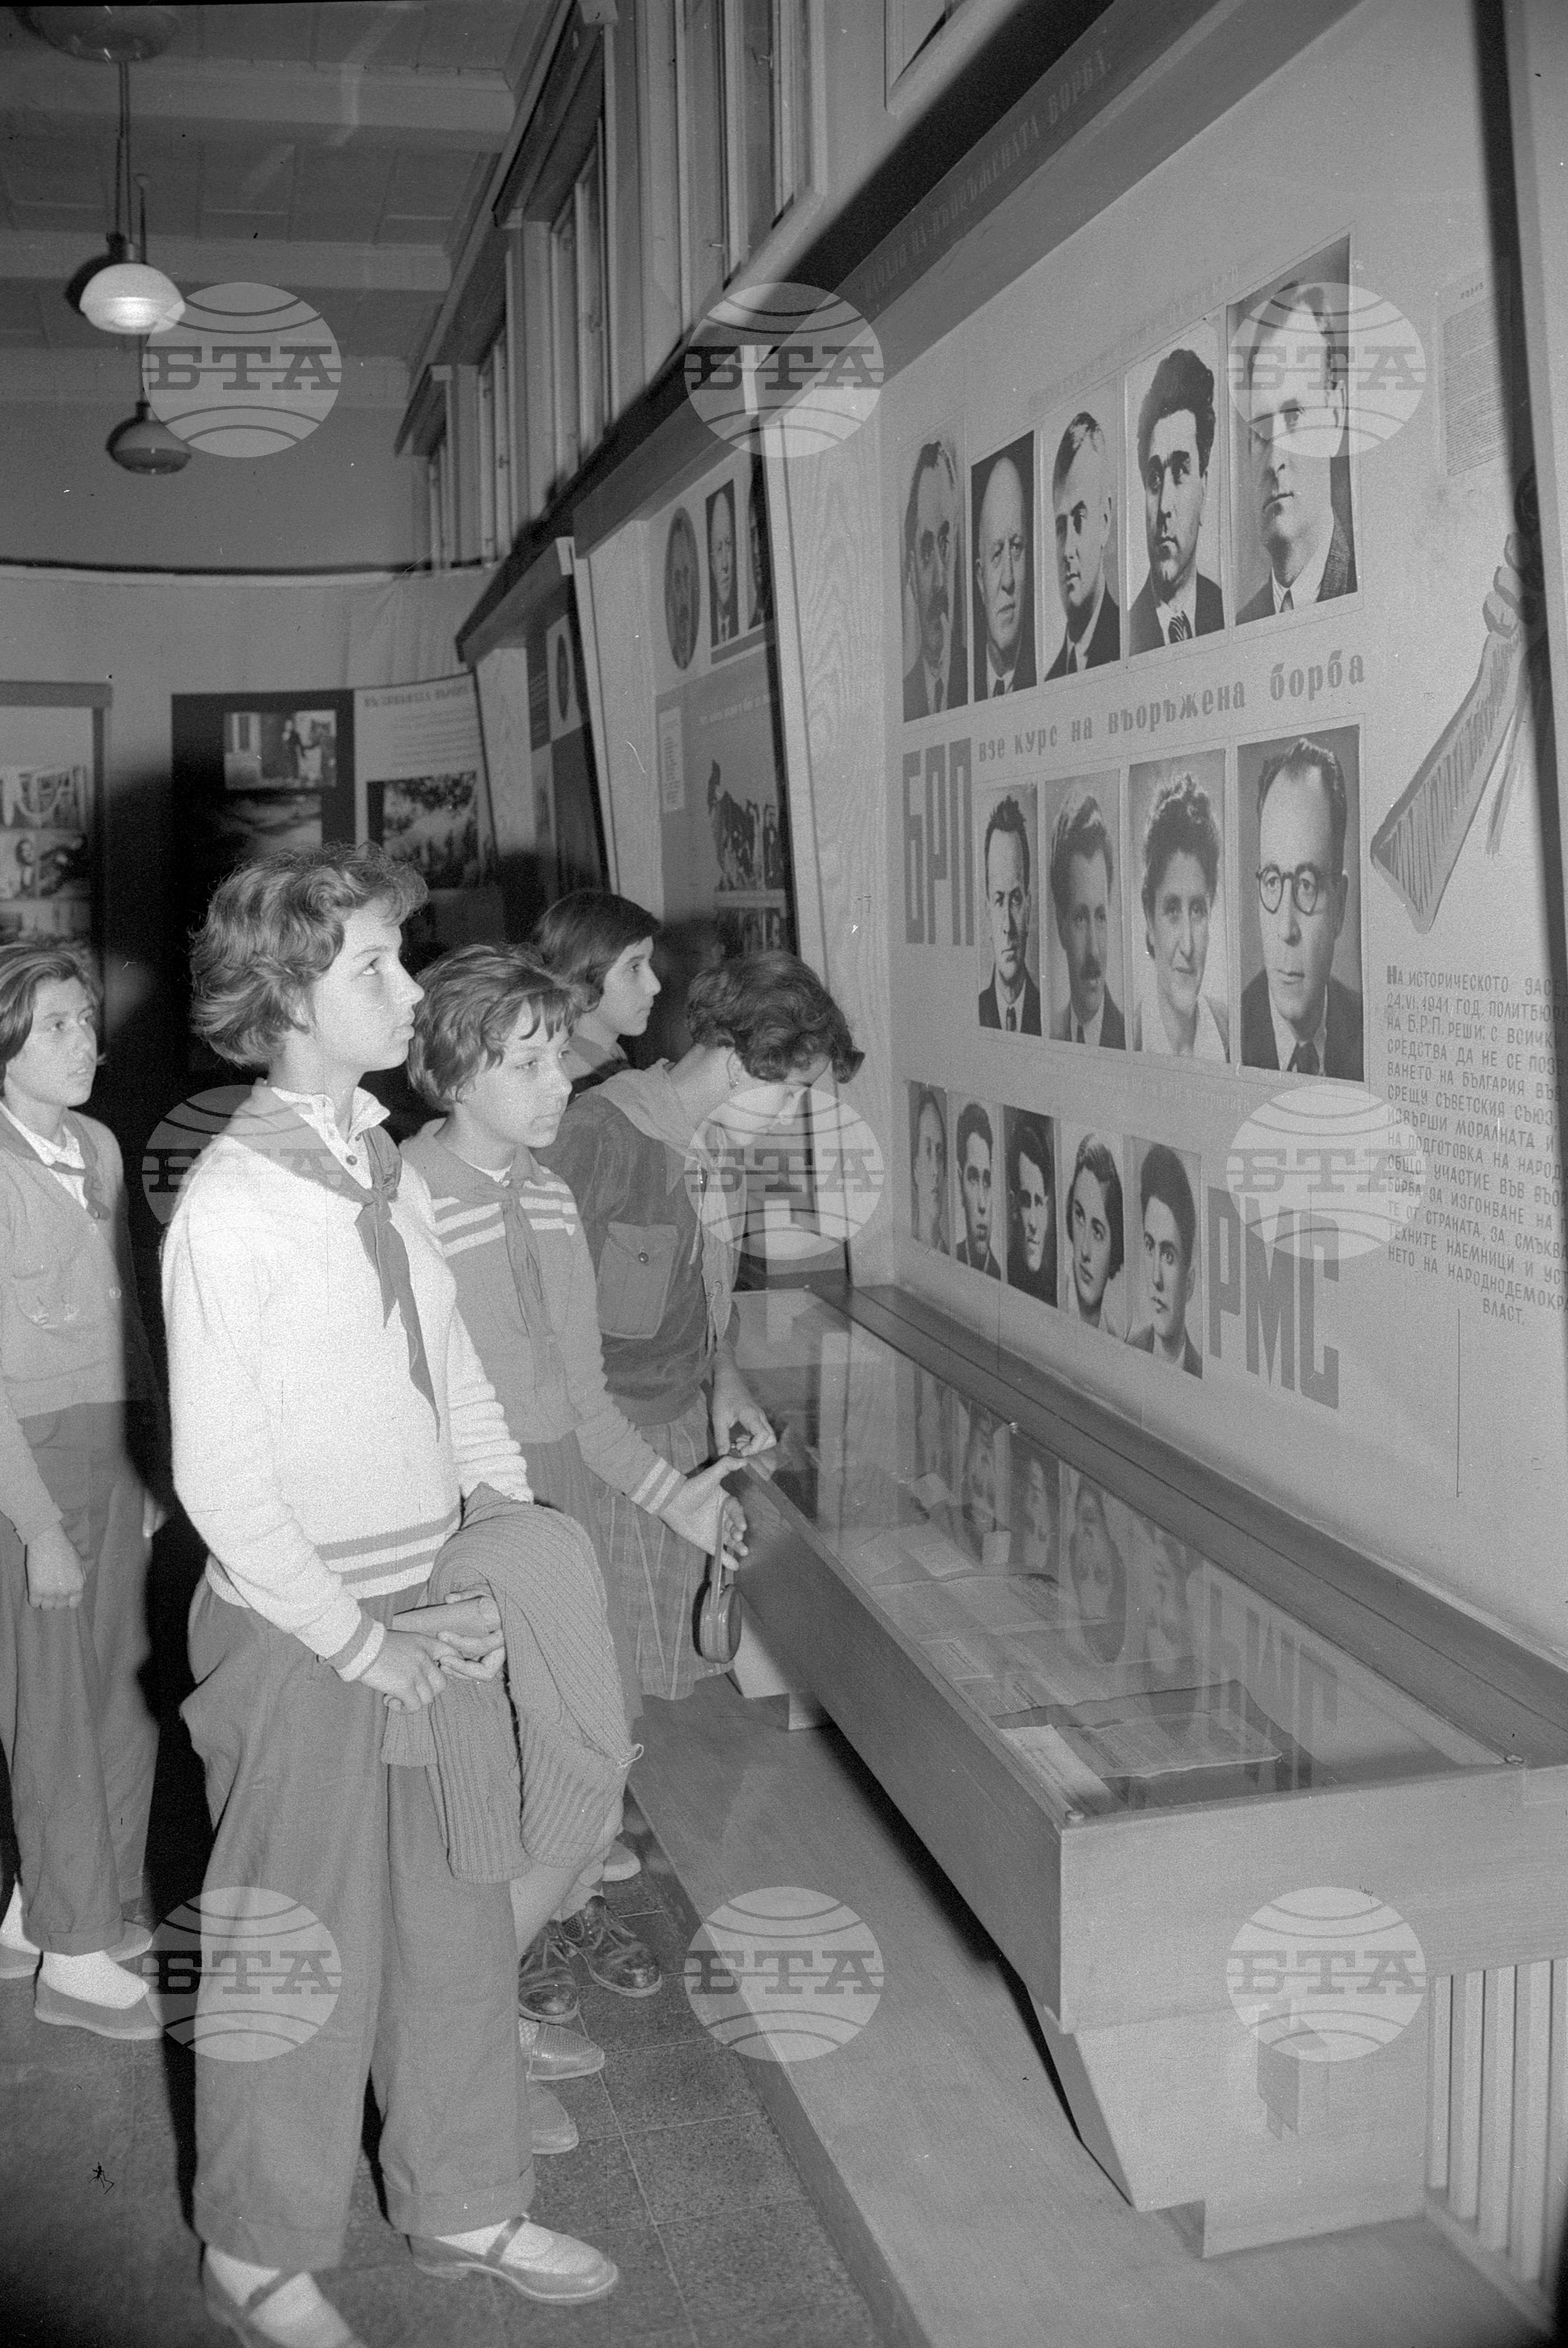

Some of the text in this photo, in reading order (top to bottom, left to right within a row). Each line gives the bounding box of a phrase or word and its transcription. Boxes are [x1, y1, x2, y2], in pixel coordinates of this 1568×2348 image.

[978, 650, 1364, 761] взе курс на въоръжена борба
[903, 737, 973, 946] БРП
[1409, 971, 1509, 993] ИСТОРИЧЕСКОТО
[1387, 1017, 1401, 1031] НА
[1408, 1014, 1444, 1035] Б.Р.П.
[1449, 1022, 1485, 1040] РЕШИ:
[1491, 1026, 1498, 1042] С
[1457, 998, 1484, 1020] ГОД.
[1387, 1038, 1447, 1060] СРЕДСТВА
[1456, 1047, 1473, 1067] ДА
[1482, 1050, 1497, 1067] НЕ
[1507, 1053, 1522, 1071] СЕ
[1388, 1061, 1432, 1081] ВАНЕТО
[1440, 1070, 1454, 1085] НА
[1462, 1071, 1525, 1095] БЪЛГАРИЯ
[1388, 1084, 1428, 1106] СРЕЩУ
[1436, 1092, 1505, 1118] СЪВЕТСКИЯ
[1388, 1108, 1554, 1153] ИЗВЪРШИ МОРАЛНАТА И
[1388, 1131, 1401, 1146] НА
[1409, 1135, 1483, 1164] ПОДГОТОВКА
[1494, 1151, 1509, 1169] НА
[1388, 1153, 1421, 1175] ОБЩО
[1434, 1164, 1490, 1192] УЧАСТИЕ
[1500, 1178, 1525, 1199] ВЪВ
[1388, 1177, 1421, 1196] БОРБА
[1430, 1186, 1442, 1203] ЗА
[1451, 1192, 1525, 1224] ИЗГОНВАНЕ
[1536, 1213, 1552, 1231] НА
[1388, 1200, 1400, 1217] ТЕ
[1407, 1205, 1420, 1220] ОТ
[1426, 1210, 1486, 1242] СТРАНАТА,
[1491, 1226, 1505, 1244] ЗА
[1388, 1223, 1437, 1251] ТЕХНИТЕ
[1447, 1239, 1515, 1275] НАЕМНИЦИ
[1525, 1260, 1534, 1278] И
[1388, 1246, 1415, 1267] НЕТО
[1424, 1256, 1438, 1274] НА
[1208, 1186, 1339, 1409] РМС
[1483, 1297, 1525, 1326] ВЛАСТ.
